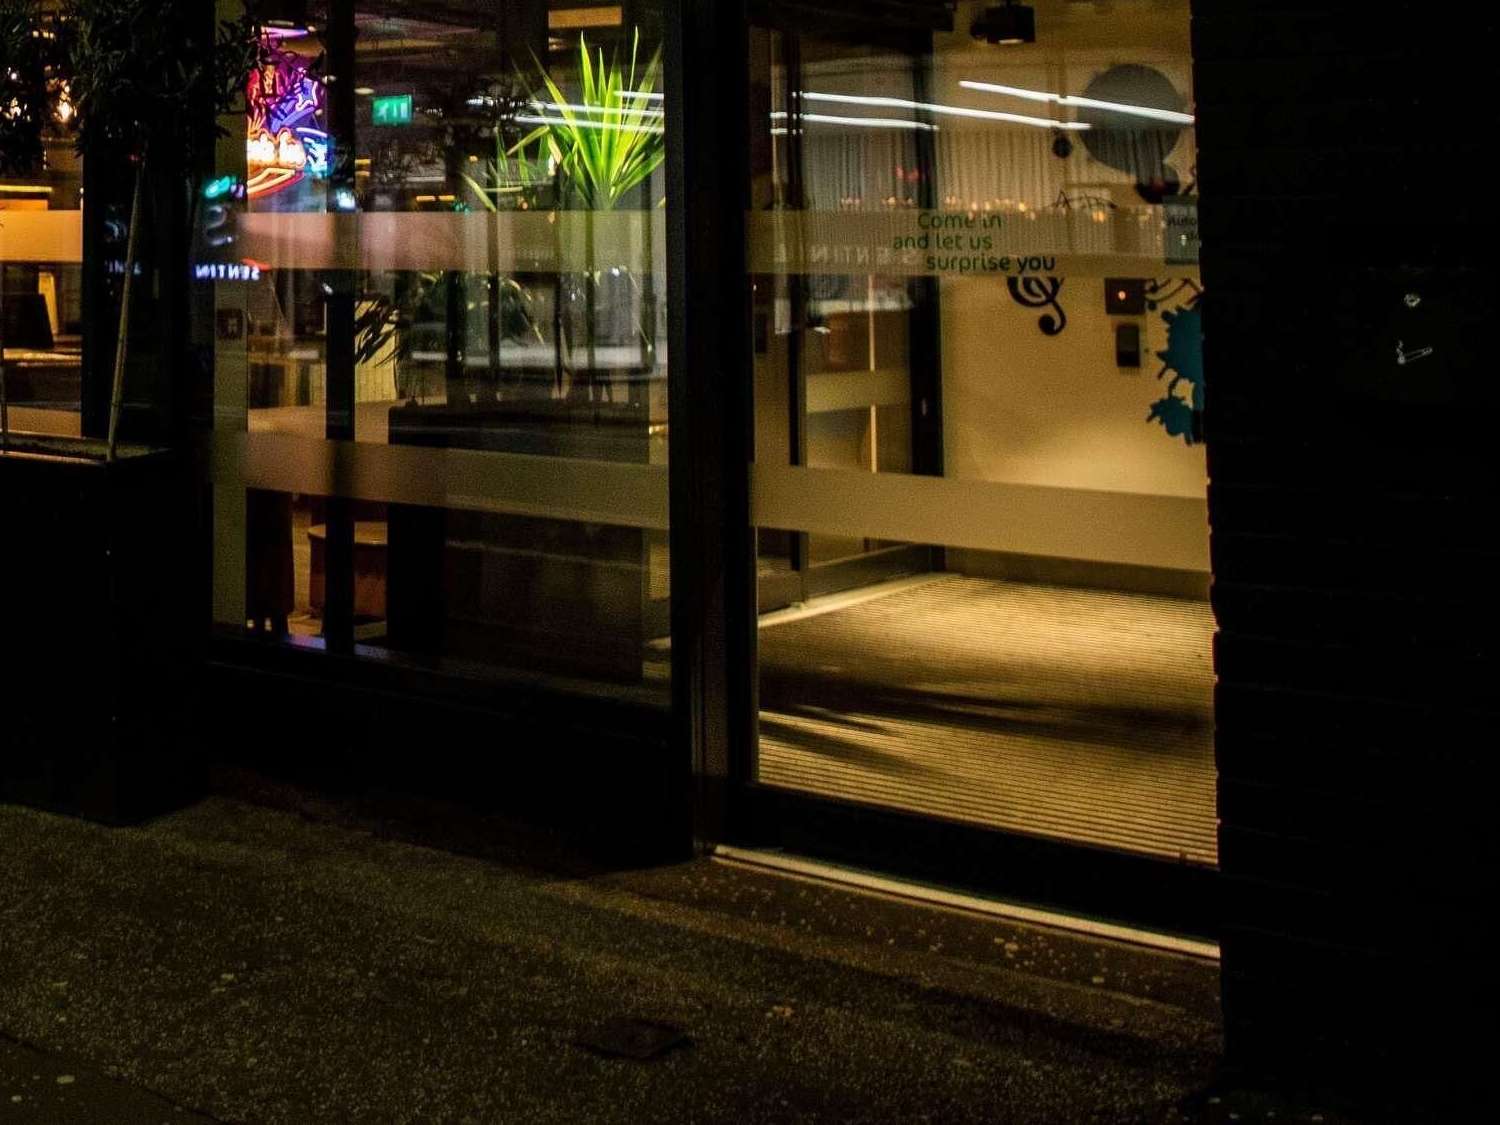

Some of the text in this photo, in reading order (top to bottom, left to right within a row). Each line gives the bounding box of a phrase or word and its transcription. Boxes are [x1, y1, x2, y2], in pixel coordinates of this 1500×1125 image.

[917, 211, 1002, 229] Come in
[893, 232, 993, 250] and let us
[926, 252, 1056, 273] surprise you
